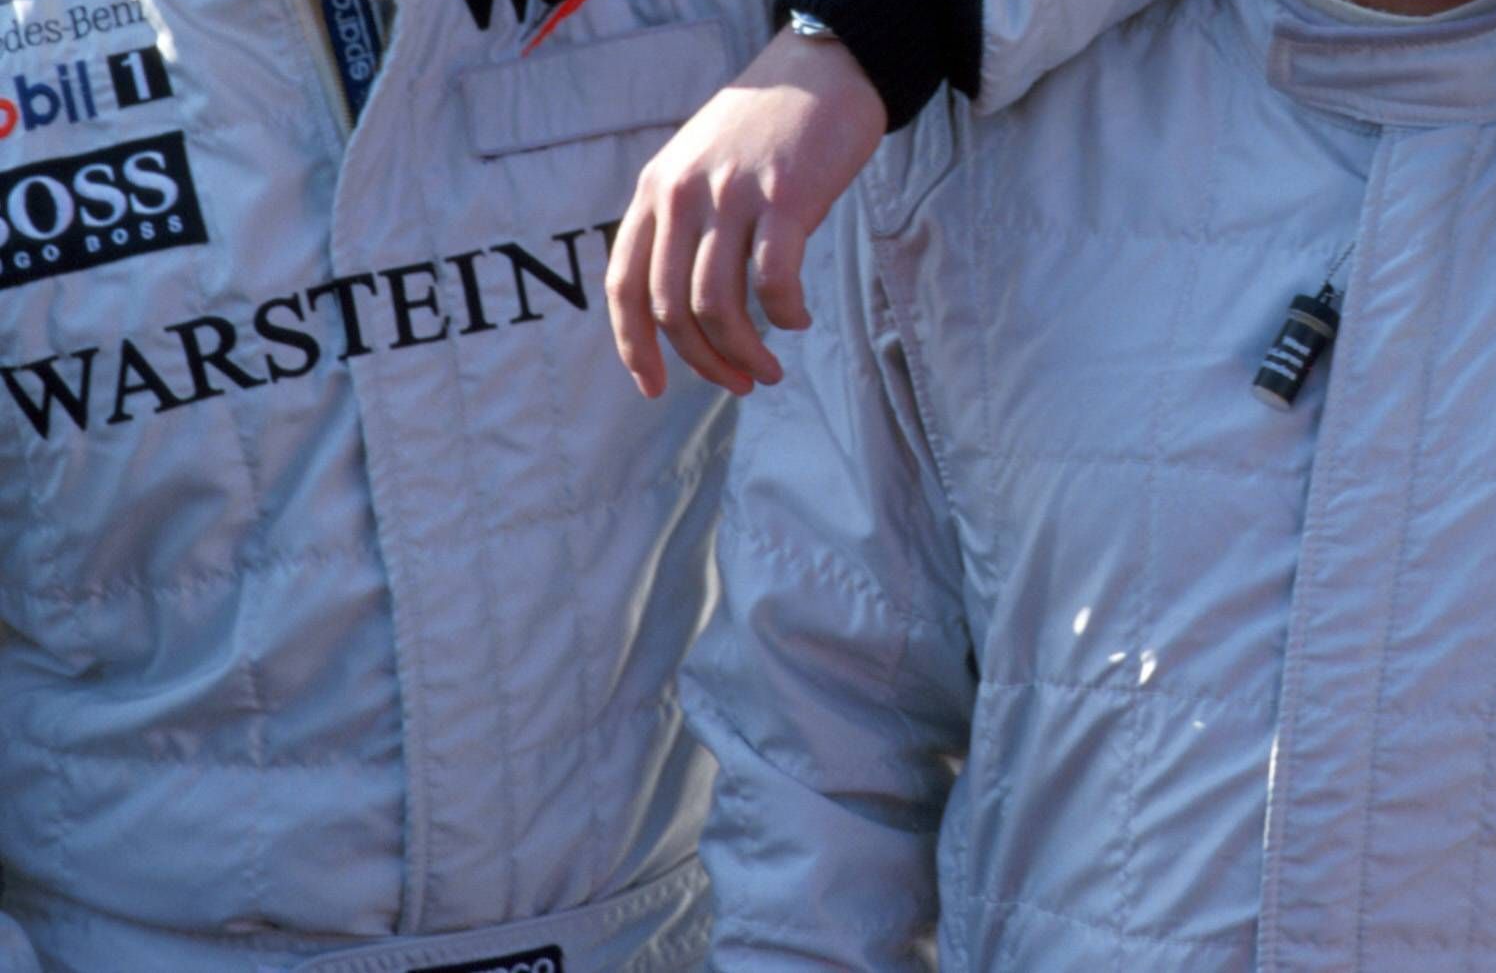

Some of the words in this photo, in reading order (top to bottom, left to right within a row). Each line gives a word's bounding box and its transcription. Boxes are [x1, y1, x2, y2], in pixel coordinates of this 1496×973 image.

[120, 59, 151, 102] 1
[0, 150, 179, 248] OSS
[0, 243, 60, 276] GO
[85, 213, 184, 253] BOSS
